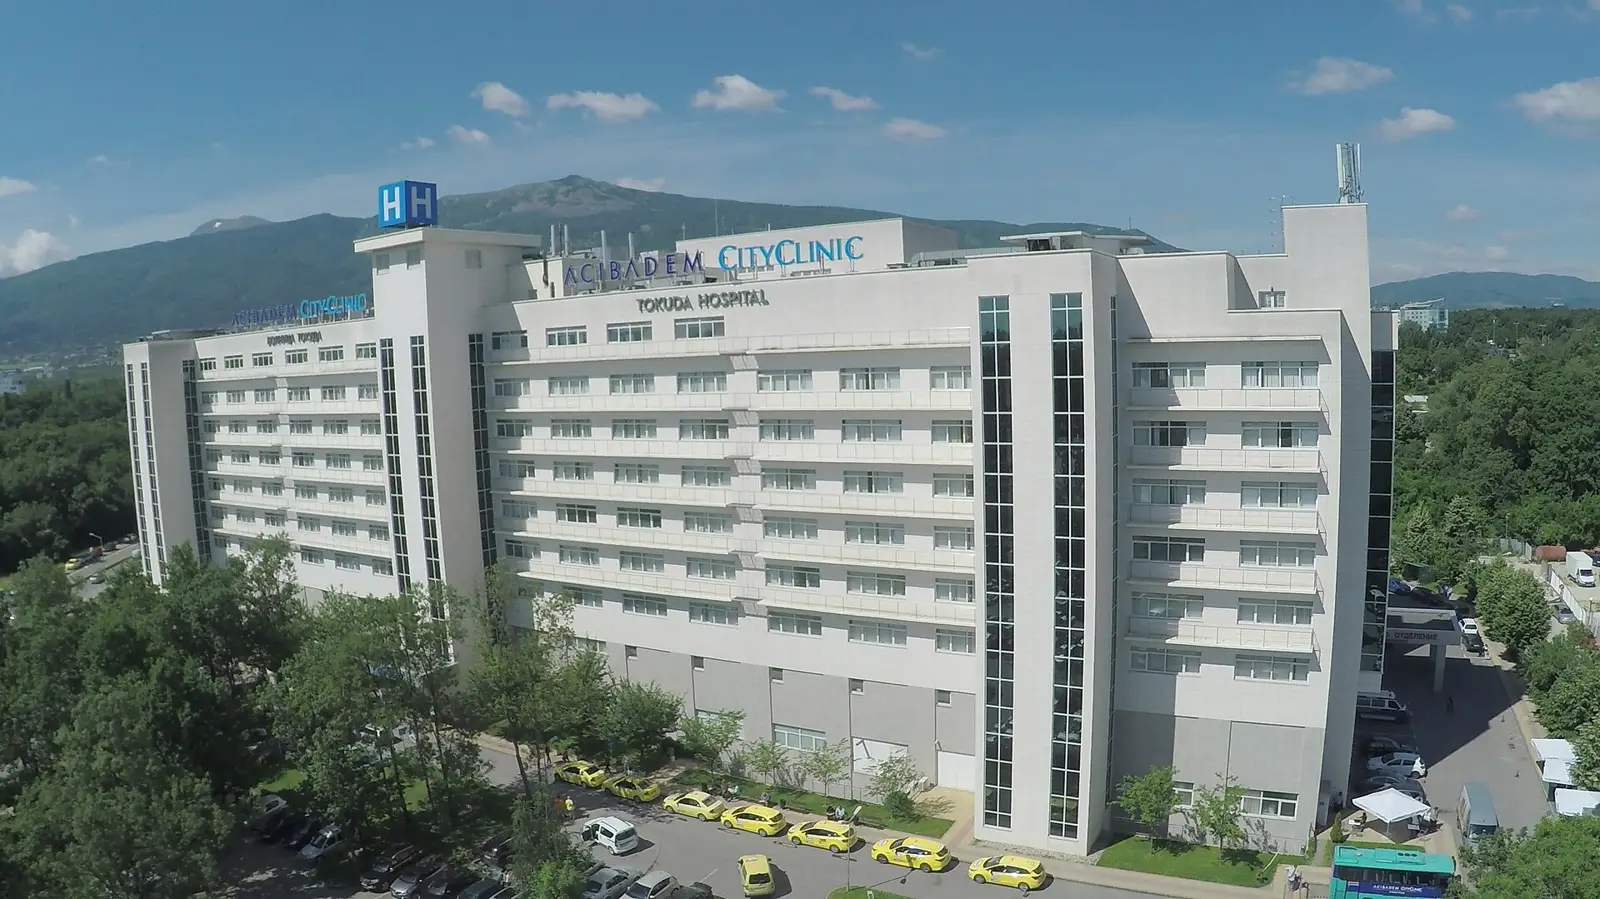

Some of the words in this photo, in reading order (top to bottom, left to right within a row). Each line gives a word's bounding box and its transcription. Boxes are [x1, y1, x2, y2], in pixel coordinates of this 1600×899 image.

[383, 186, 400, 221] H
[411, 186, 431, 219] H
[563, 249, 702, 285] ACIBADEM
[636, 295, 694, 314] TOKUDA
[698, 289, 770, 310] HOSPITAL
[1394, 632, 1438, 640] ОТДЕЛЕНИЕ
